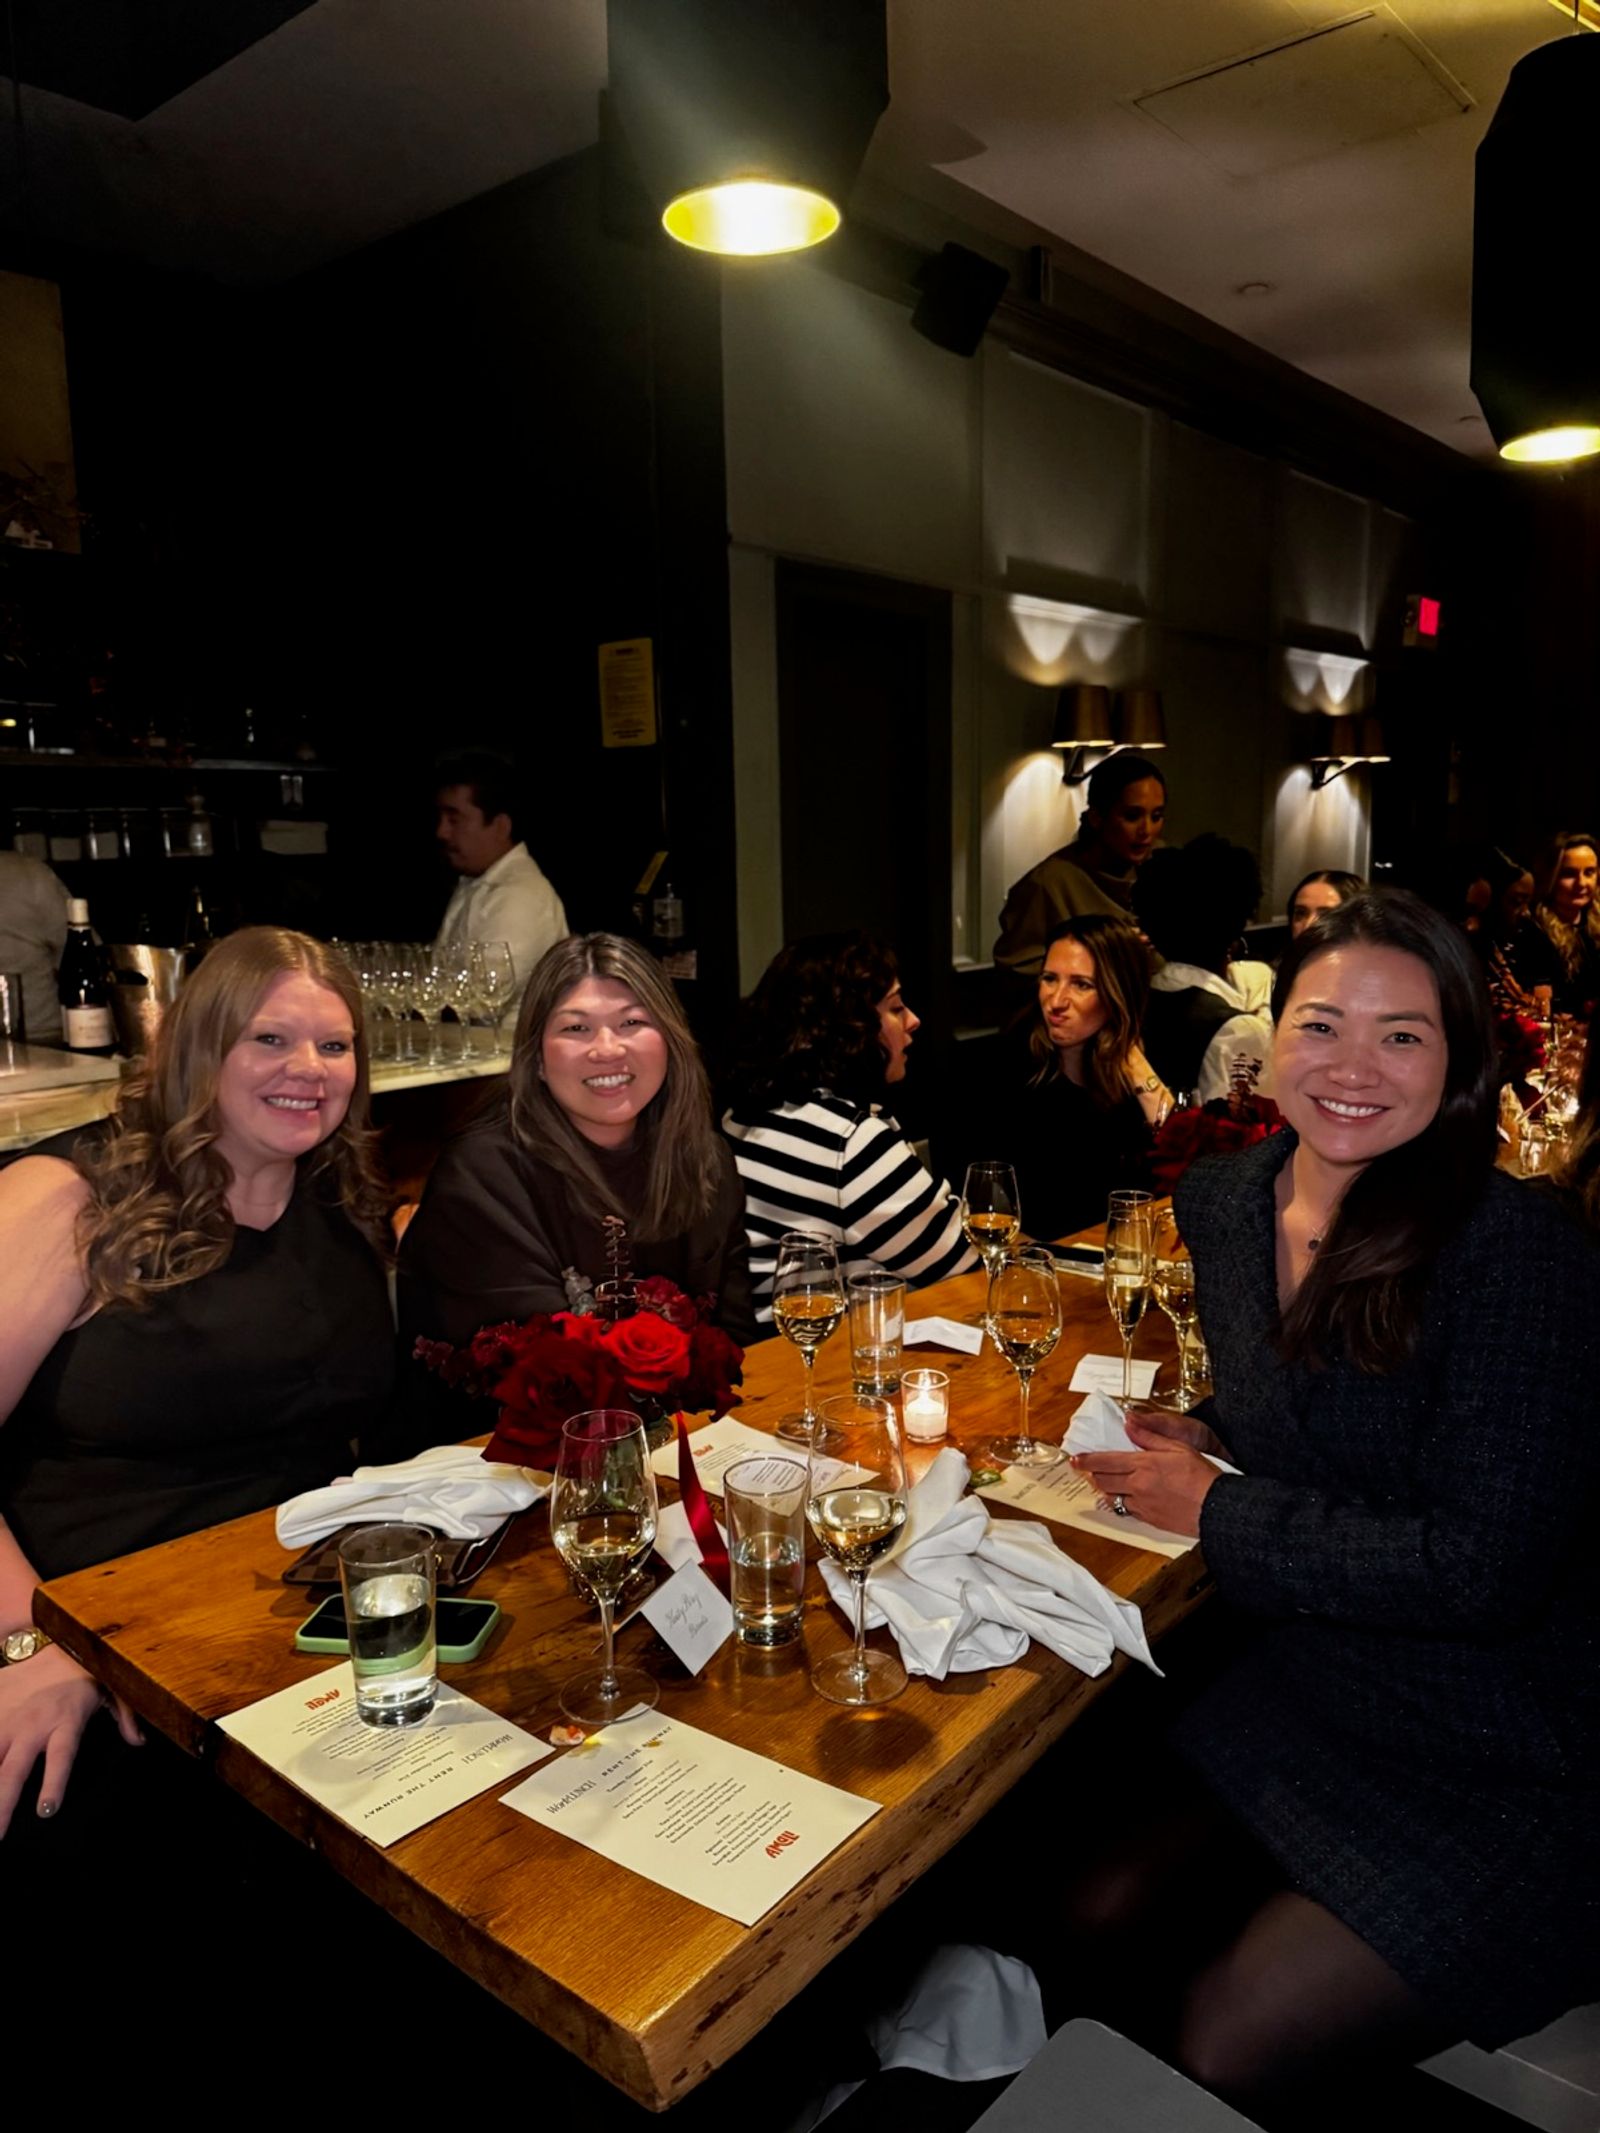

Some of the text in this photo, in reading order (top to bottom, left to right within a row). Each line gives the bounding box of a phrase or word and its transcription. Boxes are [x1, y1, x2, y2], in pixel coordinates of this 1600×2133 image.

[623, 1748, 642, 1761] THE
[363, 1767, 454, 1819] RENT THE RUNWAY
